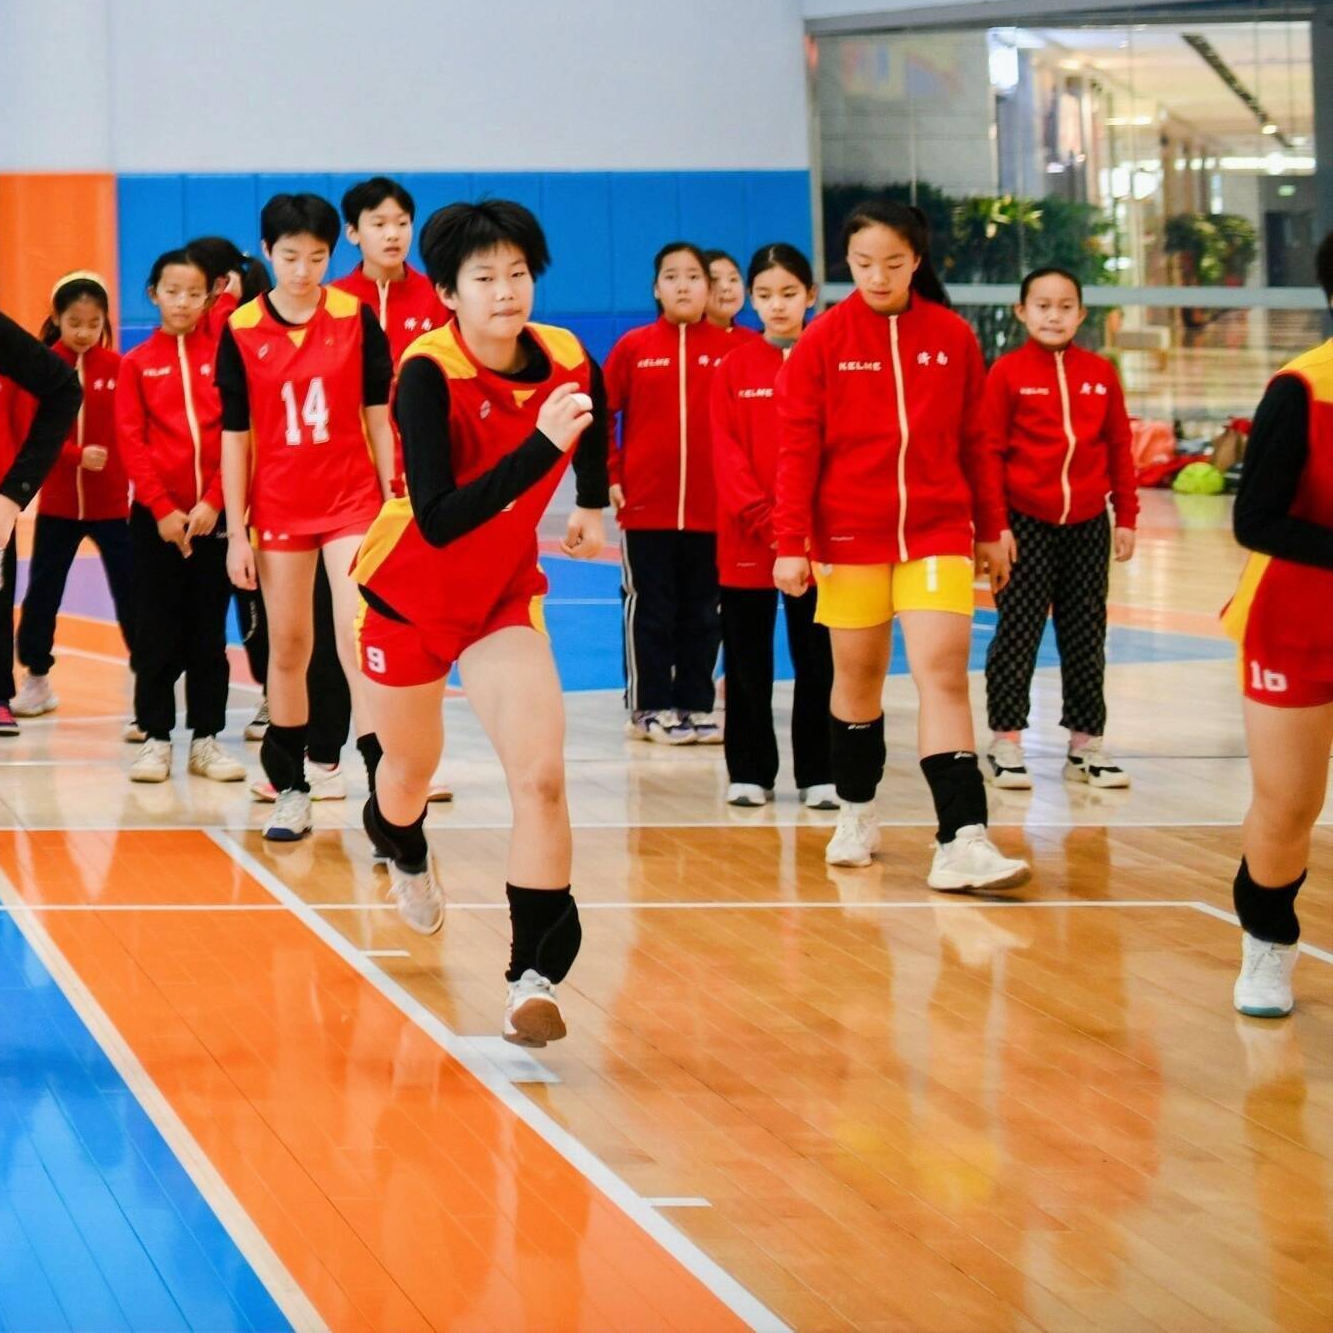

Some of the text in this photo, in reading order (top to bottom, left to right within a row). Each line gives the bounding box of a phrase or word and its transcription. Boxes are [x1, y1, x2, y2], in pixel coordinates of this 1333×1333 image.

[838, 361, 883, 372] KELME
[280, 376, 330, 446] 14
[365, 645, 388, 674] 9
[1249, 660, 1288, 693] 16
